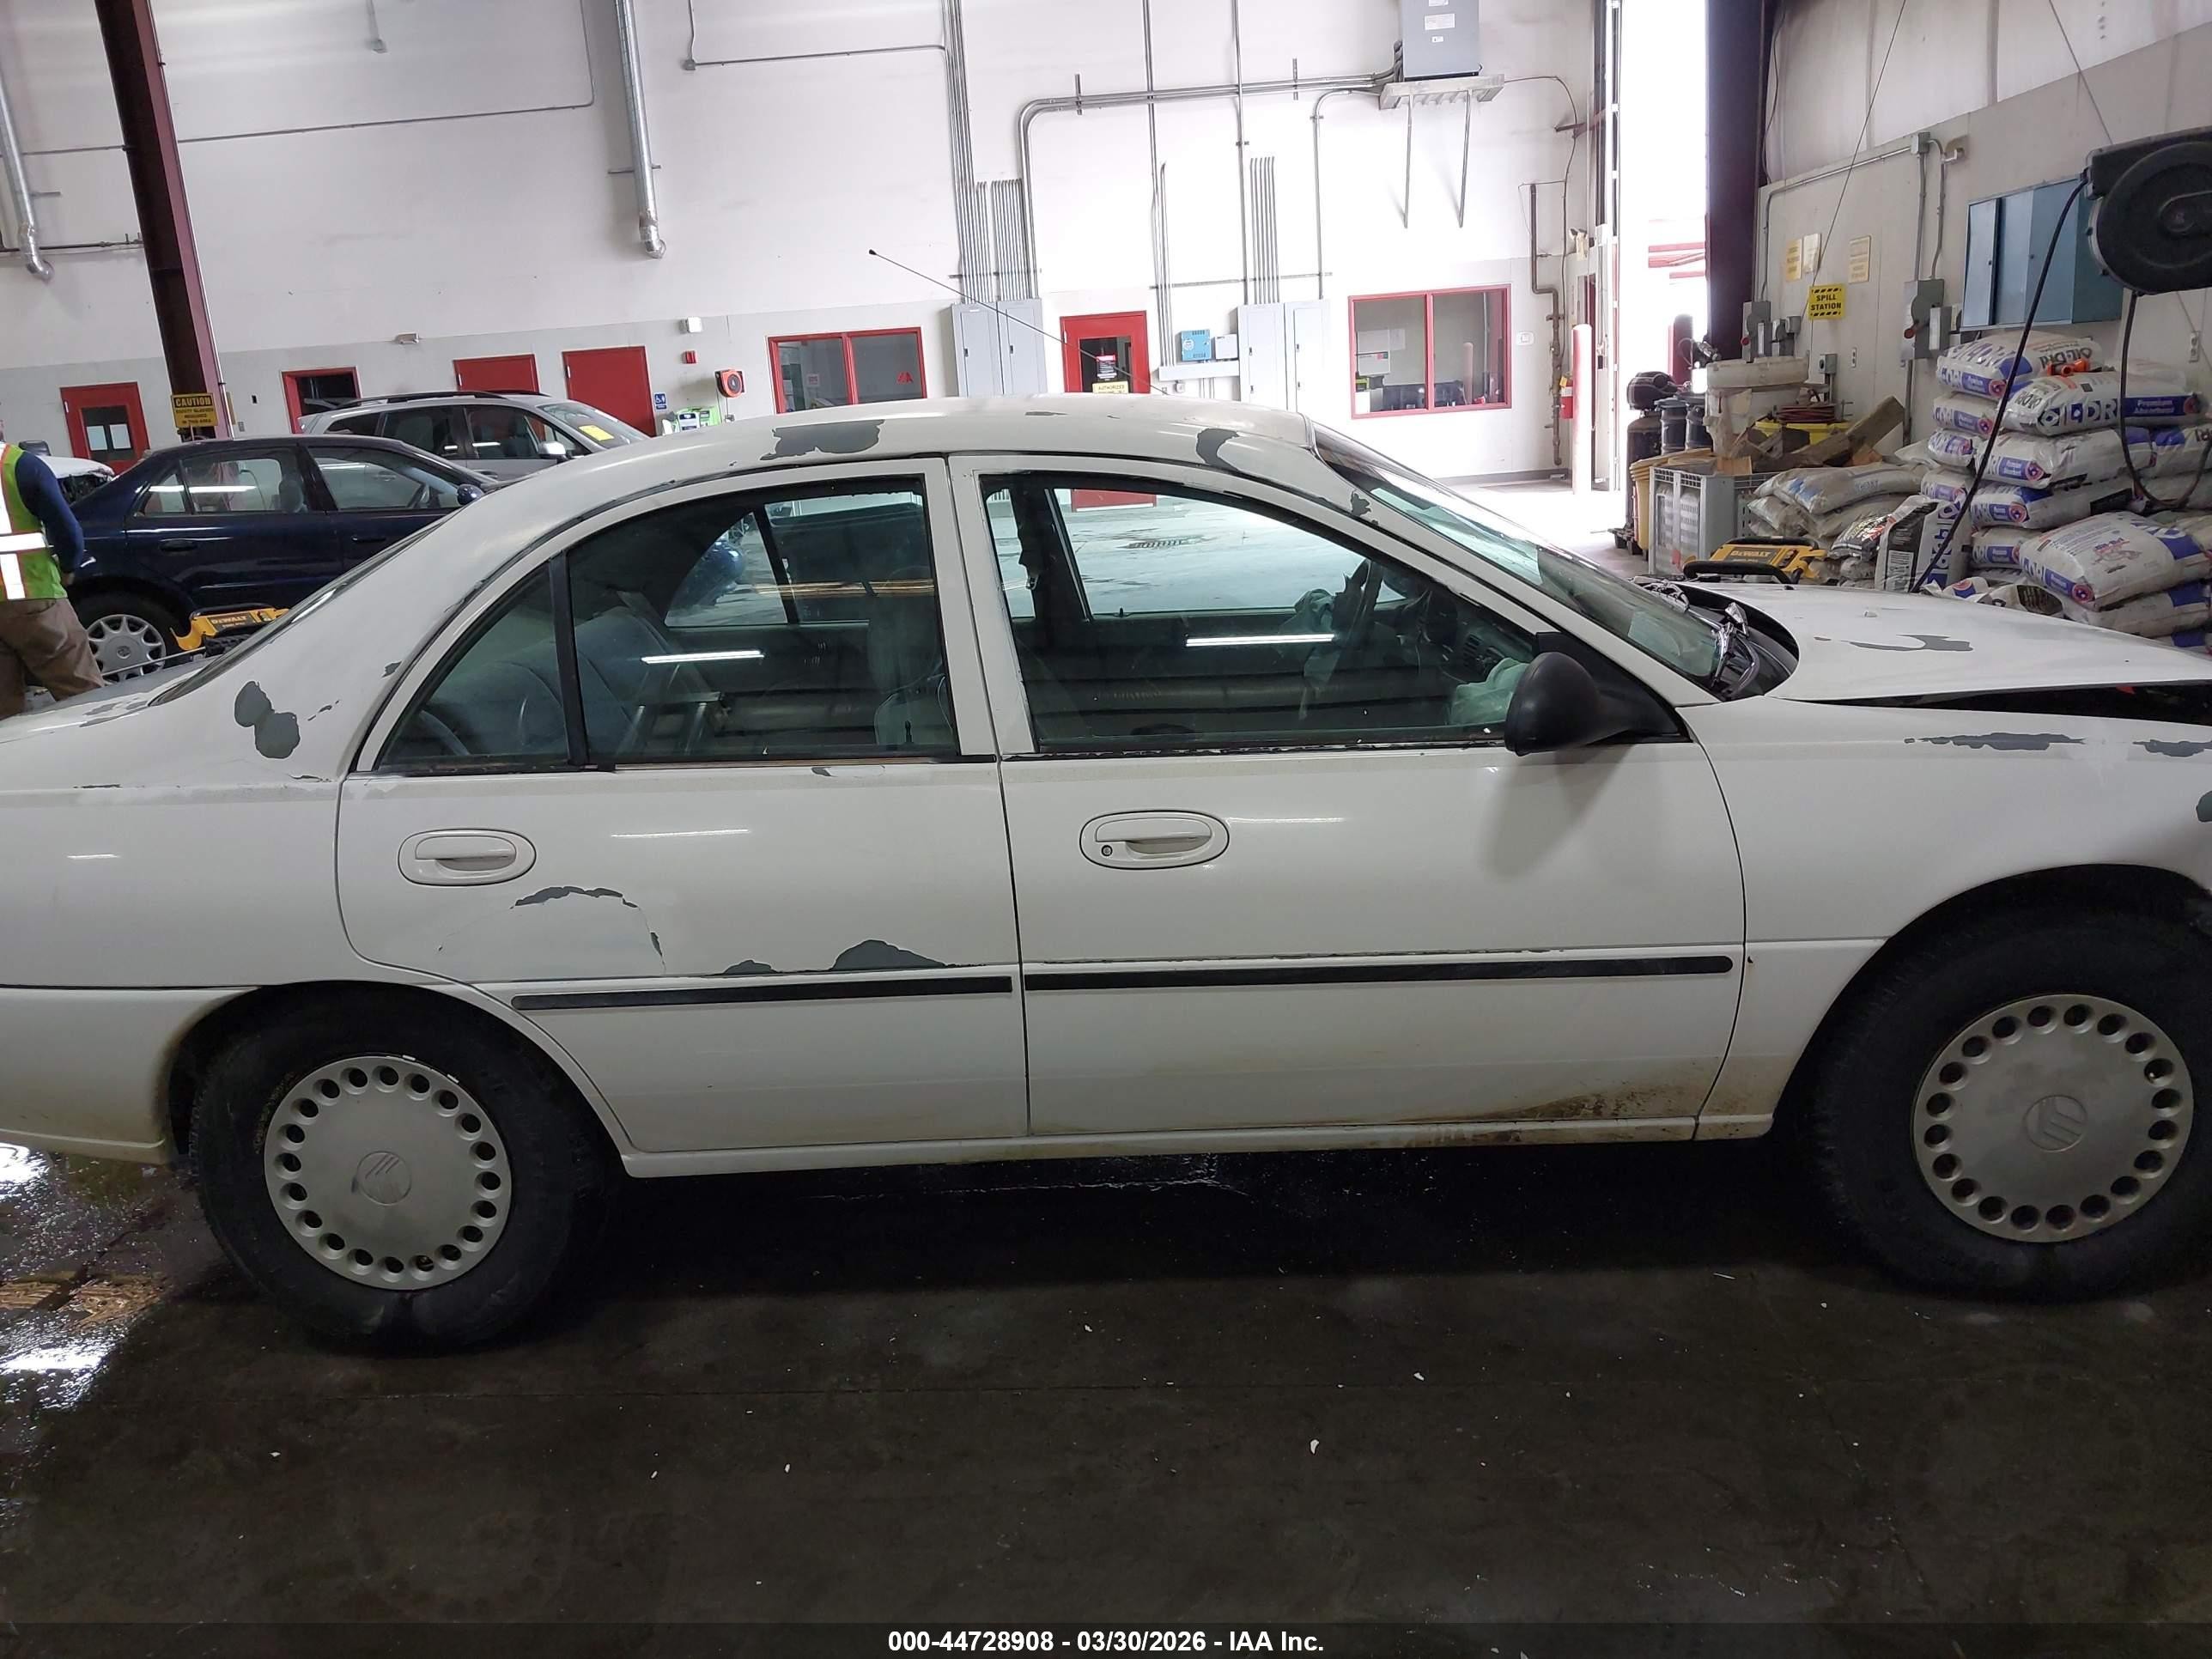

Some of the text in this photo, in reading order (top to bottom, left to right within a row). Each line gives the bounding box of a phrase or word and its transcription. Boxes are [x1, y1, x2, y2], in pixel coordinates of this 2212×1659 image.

[1816, 294, 1837, 302] SPILL
[1810, 302, 1842, 311] STATION
[175, 397, 212, 407] CAUTION
